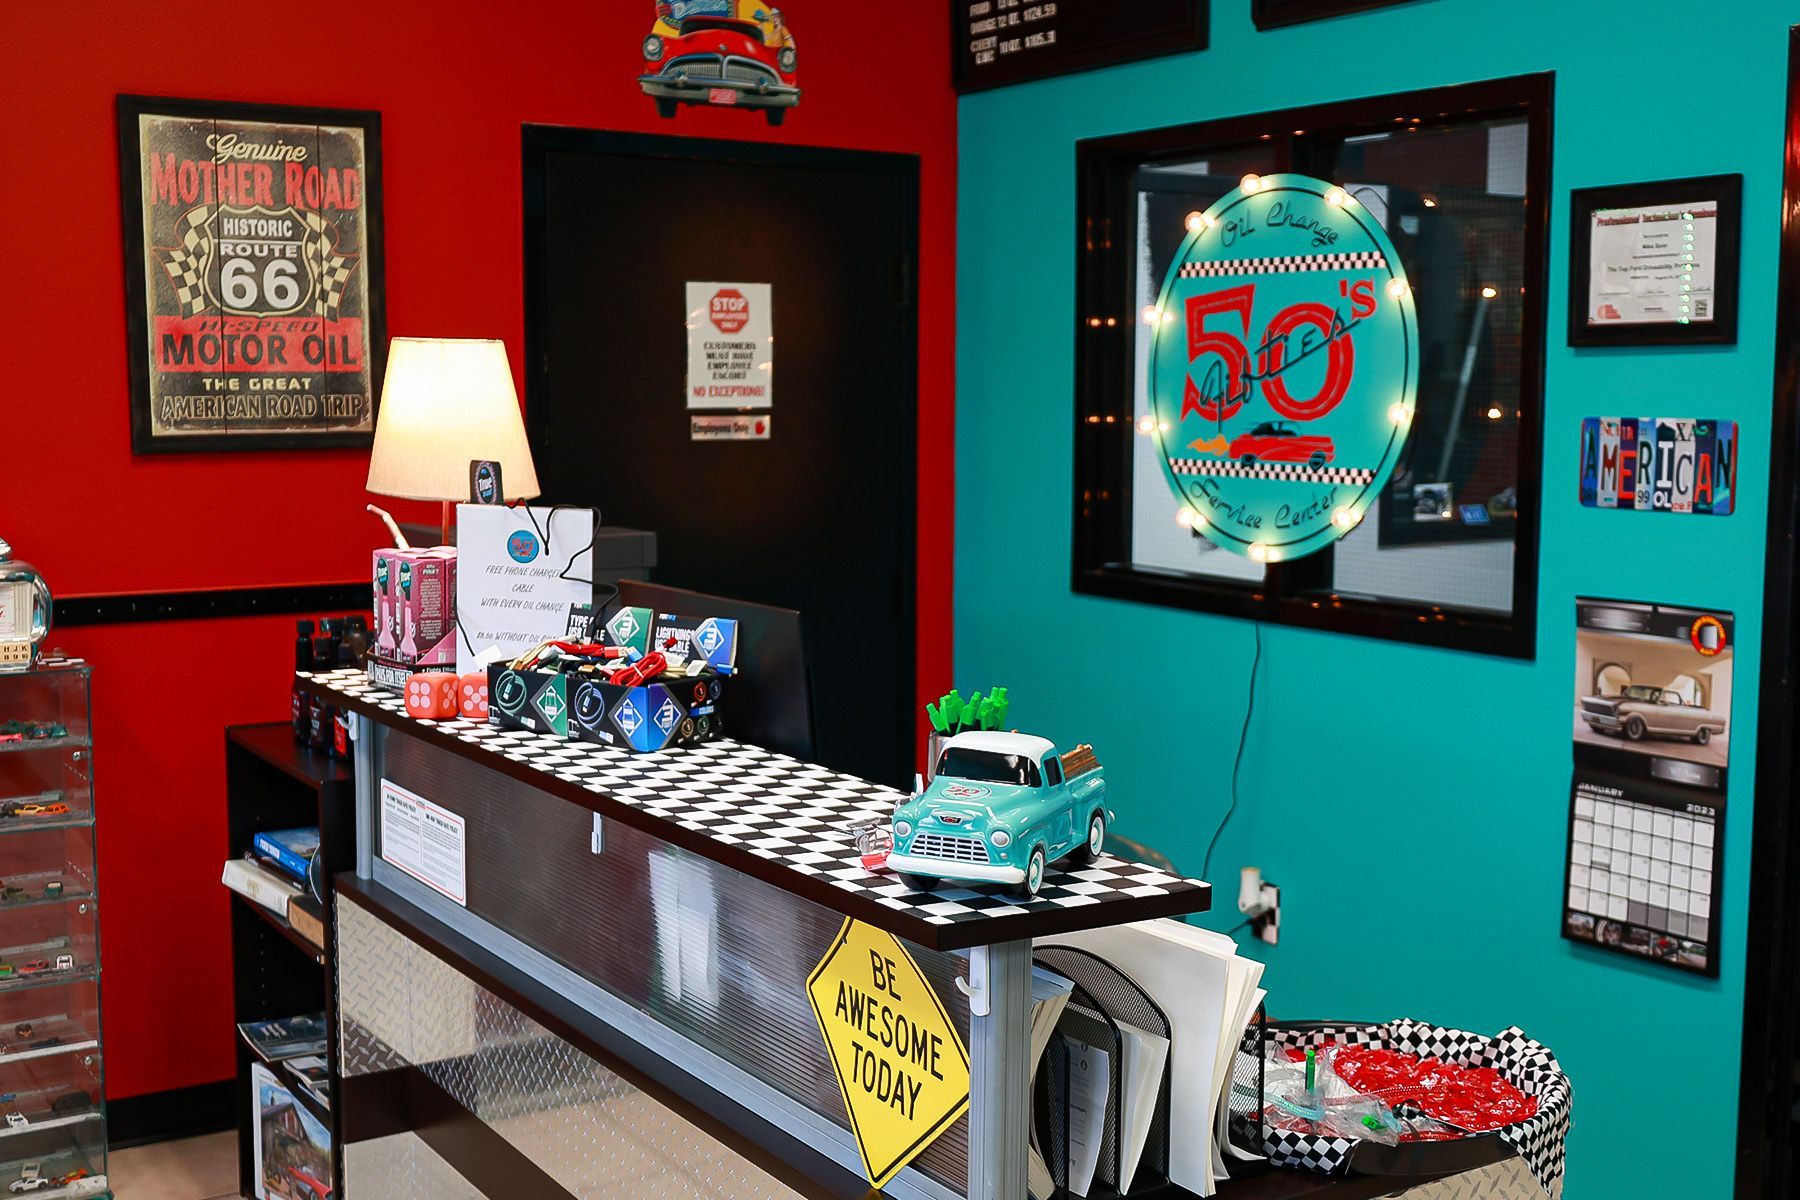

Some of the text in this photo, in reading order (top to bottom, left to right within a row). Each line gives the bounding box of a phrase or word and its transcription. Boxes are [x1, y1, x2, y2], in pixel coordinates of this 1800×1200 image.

[206, 133, 307, 164] Genuine
[150, 152, 361, 210] MOTHER ROAD
[223, 217, 293, 239] HISTORIC
[1220, 201, 1339, 248] Oil Change
[220, 242, 298, 259] ROUTE
[220, 257, 300, 309] 66
[712, 297, 746, 311] STOP
[200, 320, 320, 333] HI-SPEED
[162, 333, 357, 366] MOTOR OIL
[202, 377, 312, 391] THE GREAT
[694, 385, 706, 397] NO
[161, 394, 363, 420] AMERICAN ROAD TRIP
[1584, 427, 1732, 503] AMERICAN
[1191, 478, 1338, 528] Service Center
[485, 564, 504, 575] FREE
[504, 565, 529, 576] PHONE
[511, 583, 535, 593] CABLE
[480, 598, 500, 607] WITH
[500, 599, 522, 609] EVERY
[522, 600, 534, 610] OIL
[535, 602, 565, 613] CHANGE
[570, 614, 588, 628] TYPE
[495, 631, 530, 641] WITHOUT
[529, 634, 540, 642] OIL
[1577, 782, 1624, 797] JANUARY
[1686, 803, 1715, 816] 2023
[869, 948, 901, 1002] BE
[835, 980, 943, 1081] AWESOME
[851, 1040, 922, 1121] TODAY
